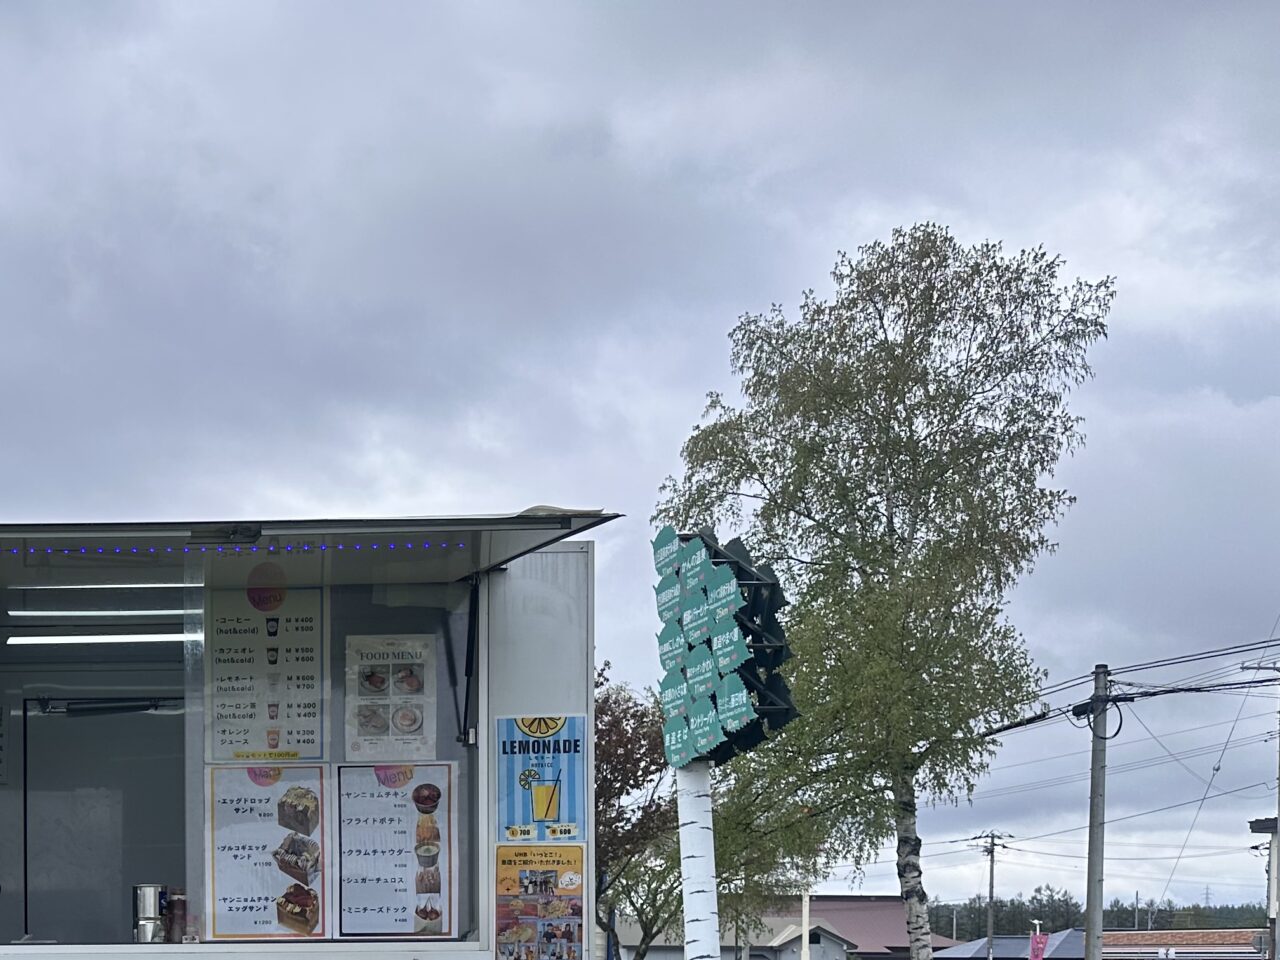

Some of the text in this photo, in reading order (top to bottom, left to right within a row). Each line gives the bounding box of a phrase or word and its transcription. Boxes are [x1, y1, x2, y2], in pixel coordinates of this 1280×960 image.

[360, 651, 422, 661] FOOD MENU
[502, 739, 581, 755] LEMONADE
[377, 768, 413, 786] Menu
